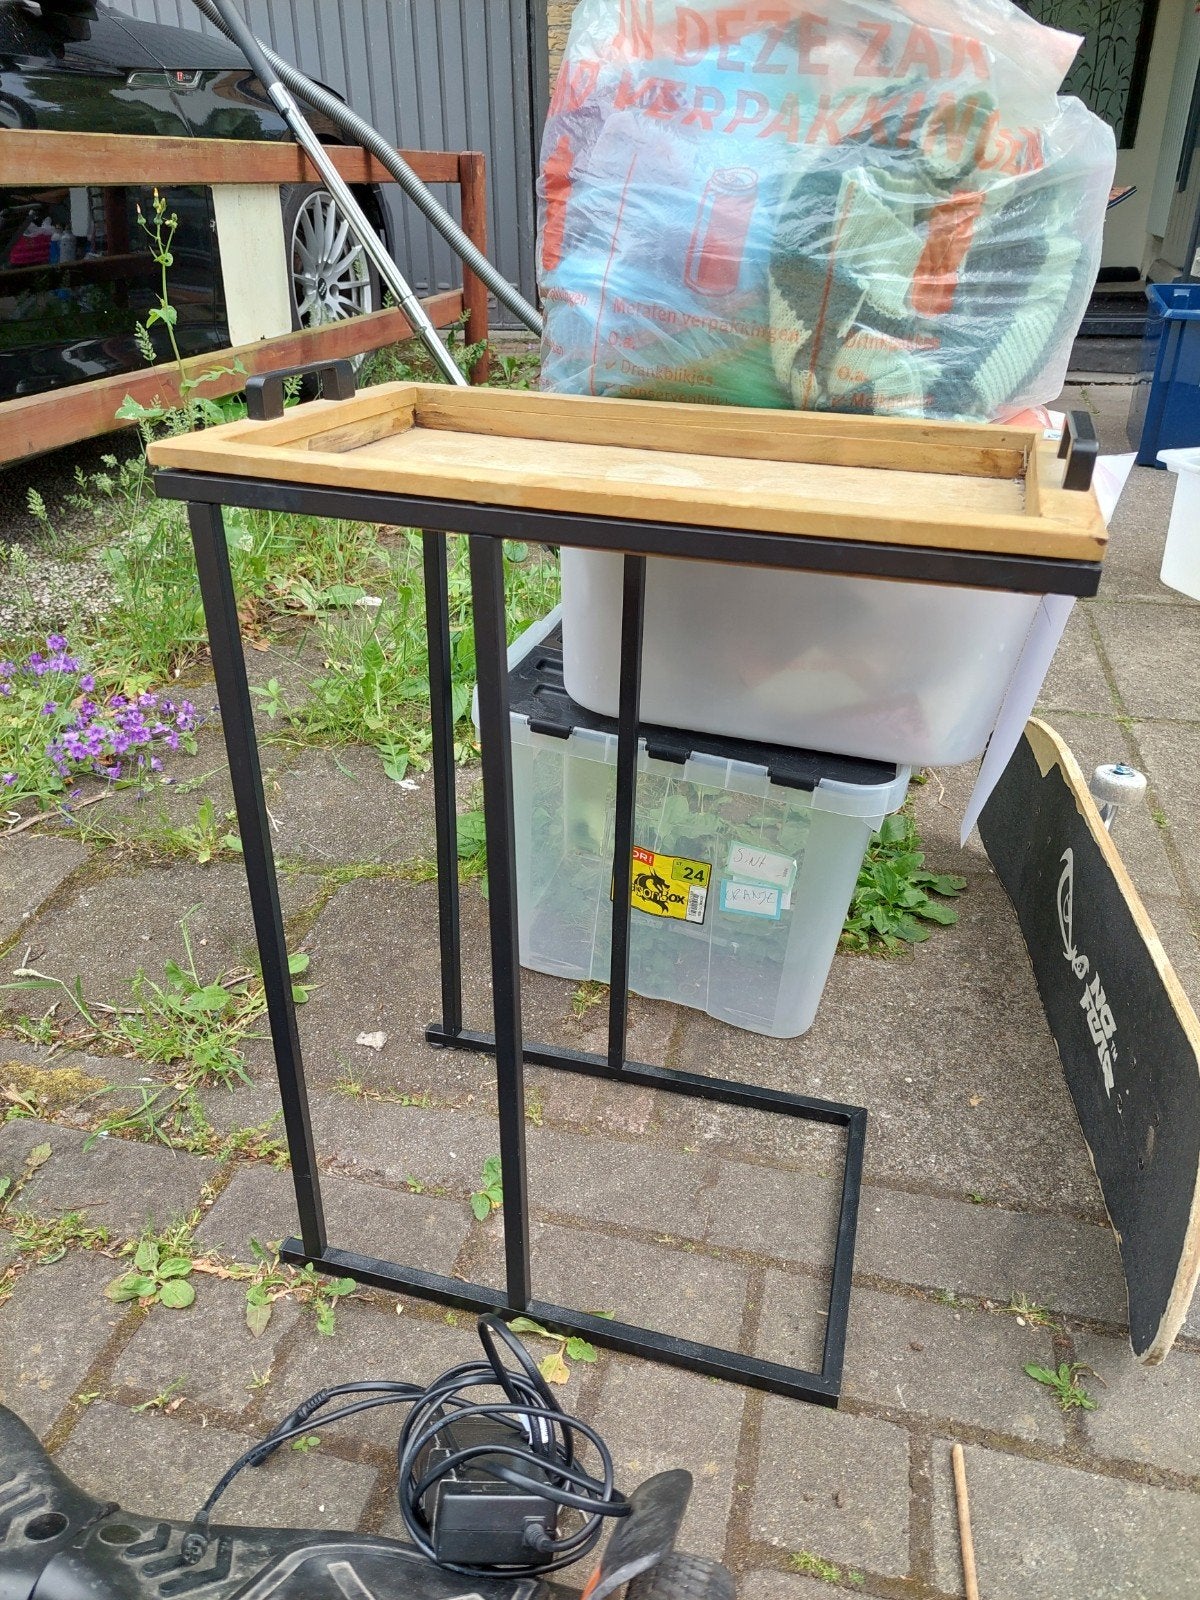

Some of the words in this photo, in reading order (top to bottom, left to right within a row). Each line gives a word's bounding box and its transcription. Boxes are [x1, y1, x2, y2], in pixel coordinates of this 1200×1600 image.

[674, 5, 829, 75] DEZE
[853, 20, 990, 80] ZAK
[620, 359, 715, 386] Drankblikjes
[683, 866, 705, 883] 24
[1088, 970, 1117, 1041] NO
[1079, 982, 1115, 1101] FEAR
